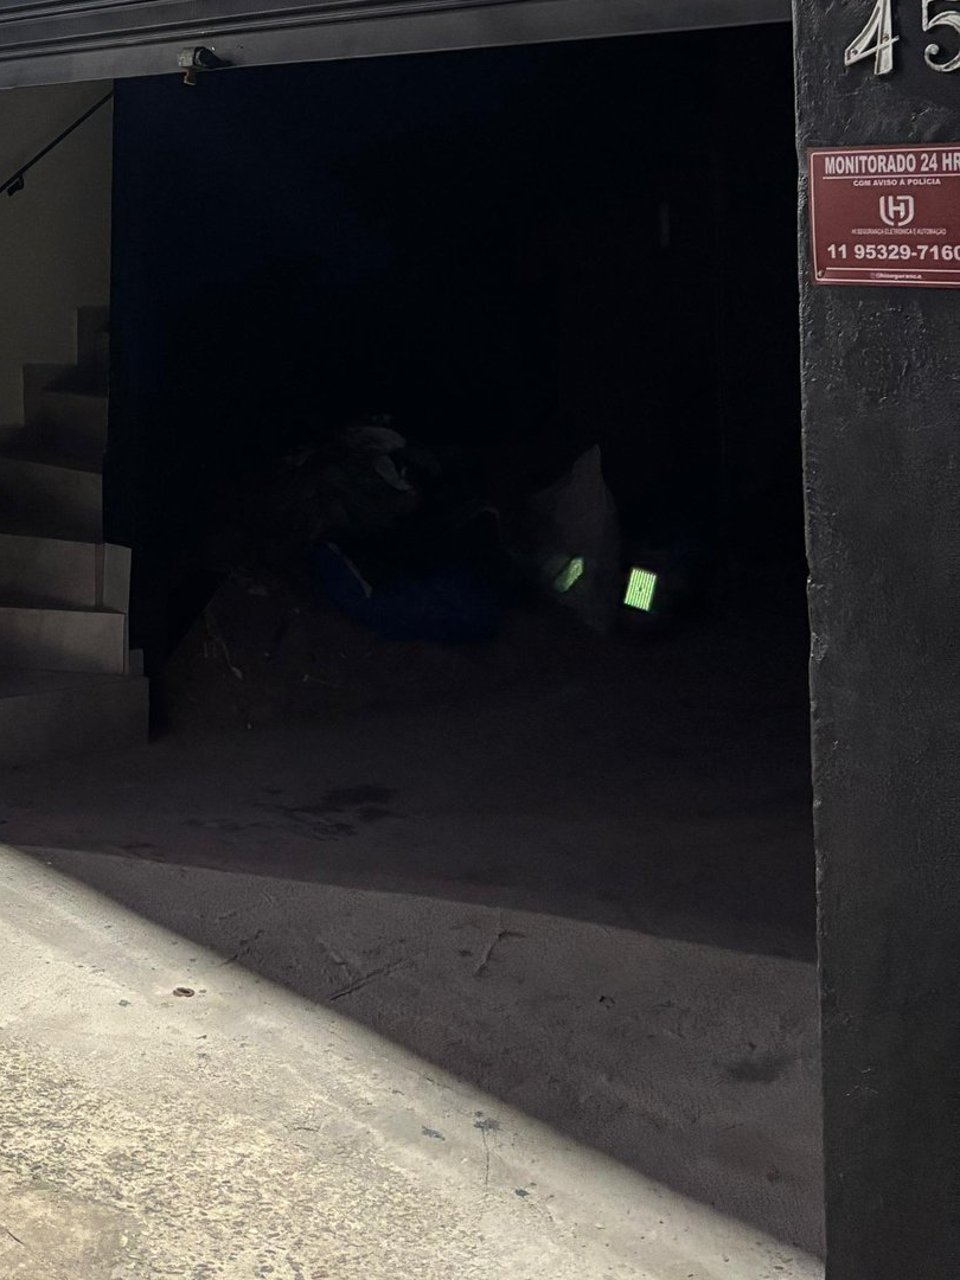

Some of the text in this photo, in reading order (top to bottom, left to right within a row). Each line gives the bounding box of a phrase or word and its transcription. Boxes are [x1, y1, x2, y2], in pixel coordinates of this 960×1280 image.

[824, 154, 916, 174] MONITORADO
[921, 153, 938, 172] 24
[853, 179, 871, 187] COM
[826, 243, 847, 260] 11
